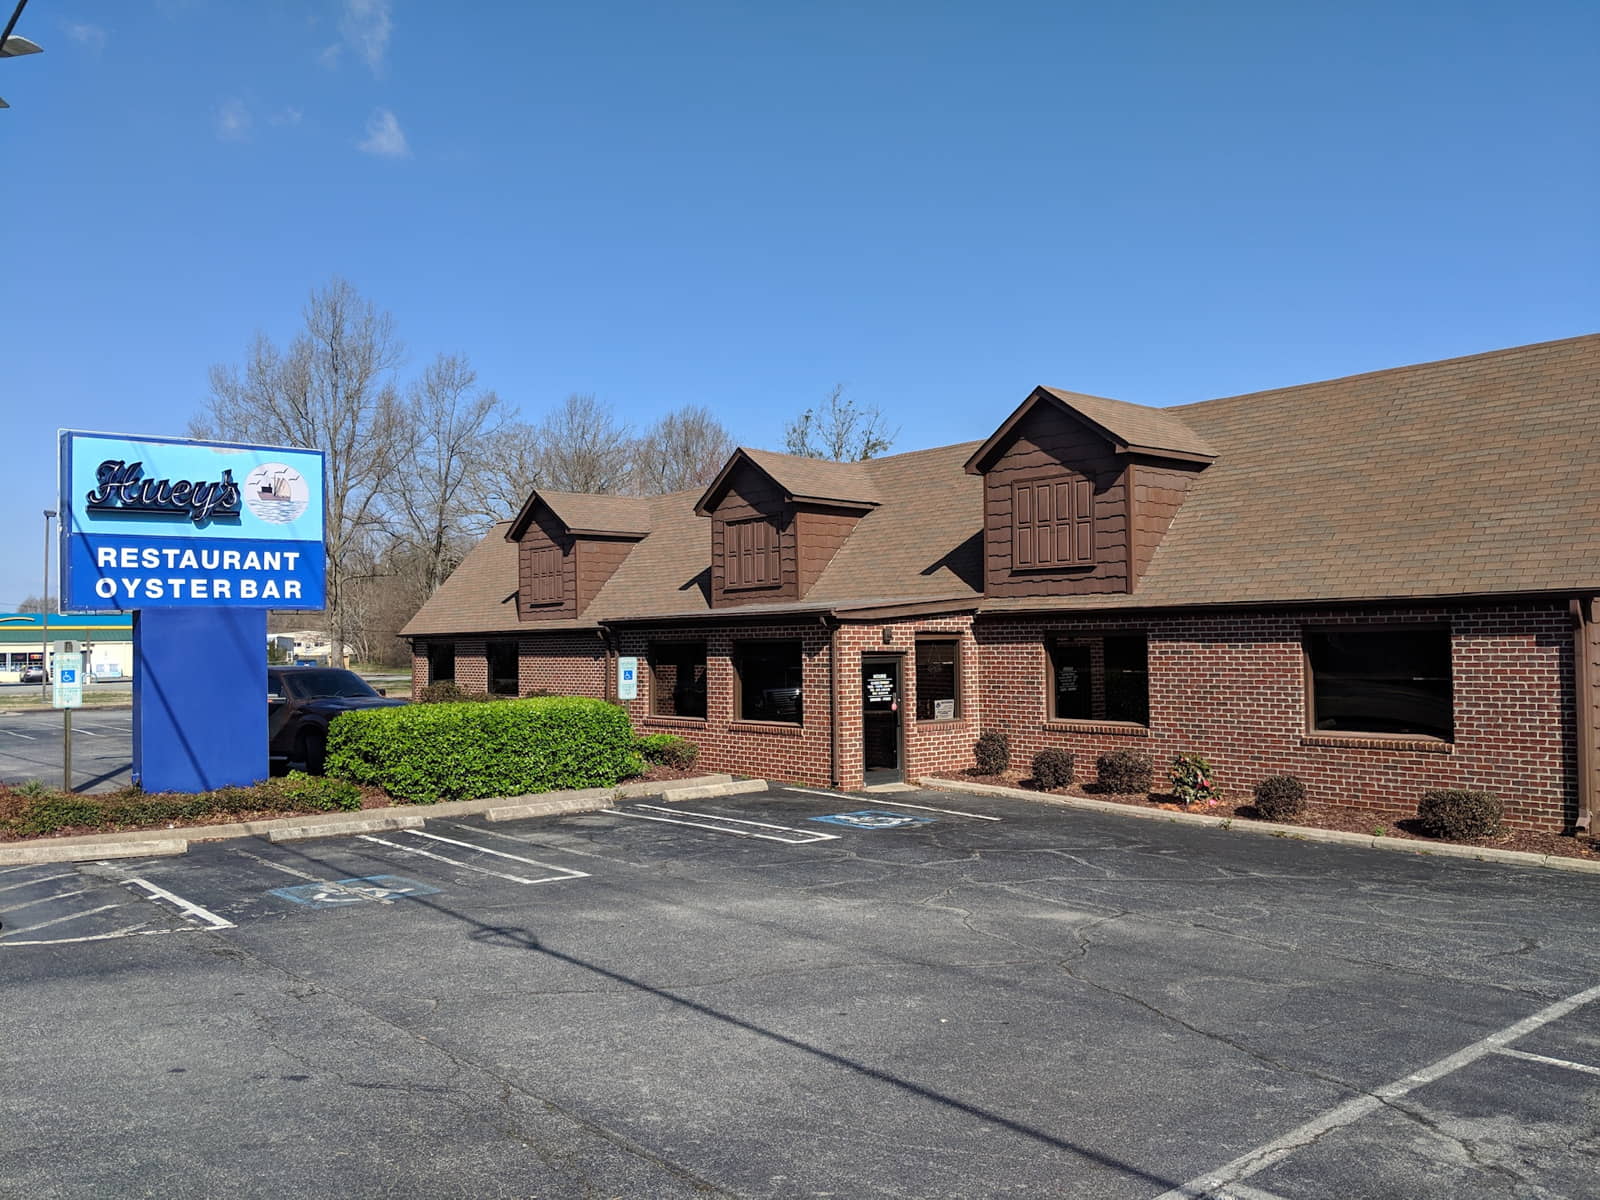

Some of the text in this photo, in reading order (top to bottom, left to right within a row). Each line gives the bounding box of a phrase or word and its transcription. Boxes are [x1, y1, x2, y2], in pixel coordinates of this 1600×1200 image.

[87, 460, 240, 521] Huey's
[97, 547, 300, 571] RESTAURANT
[95, 578, 302, 600] OYSTER BAR
